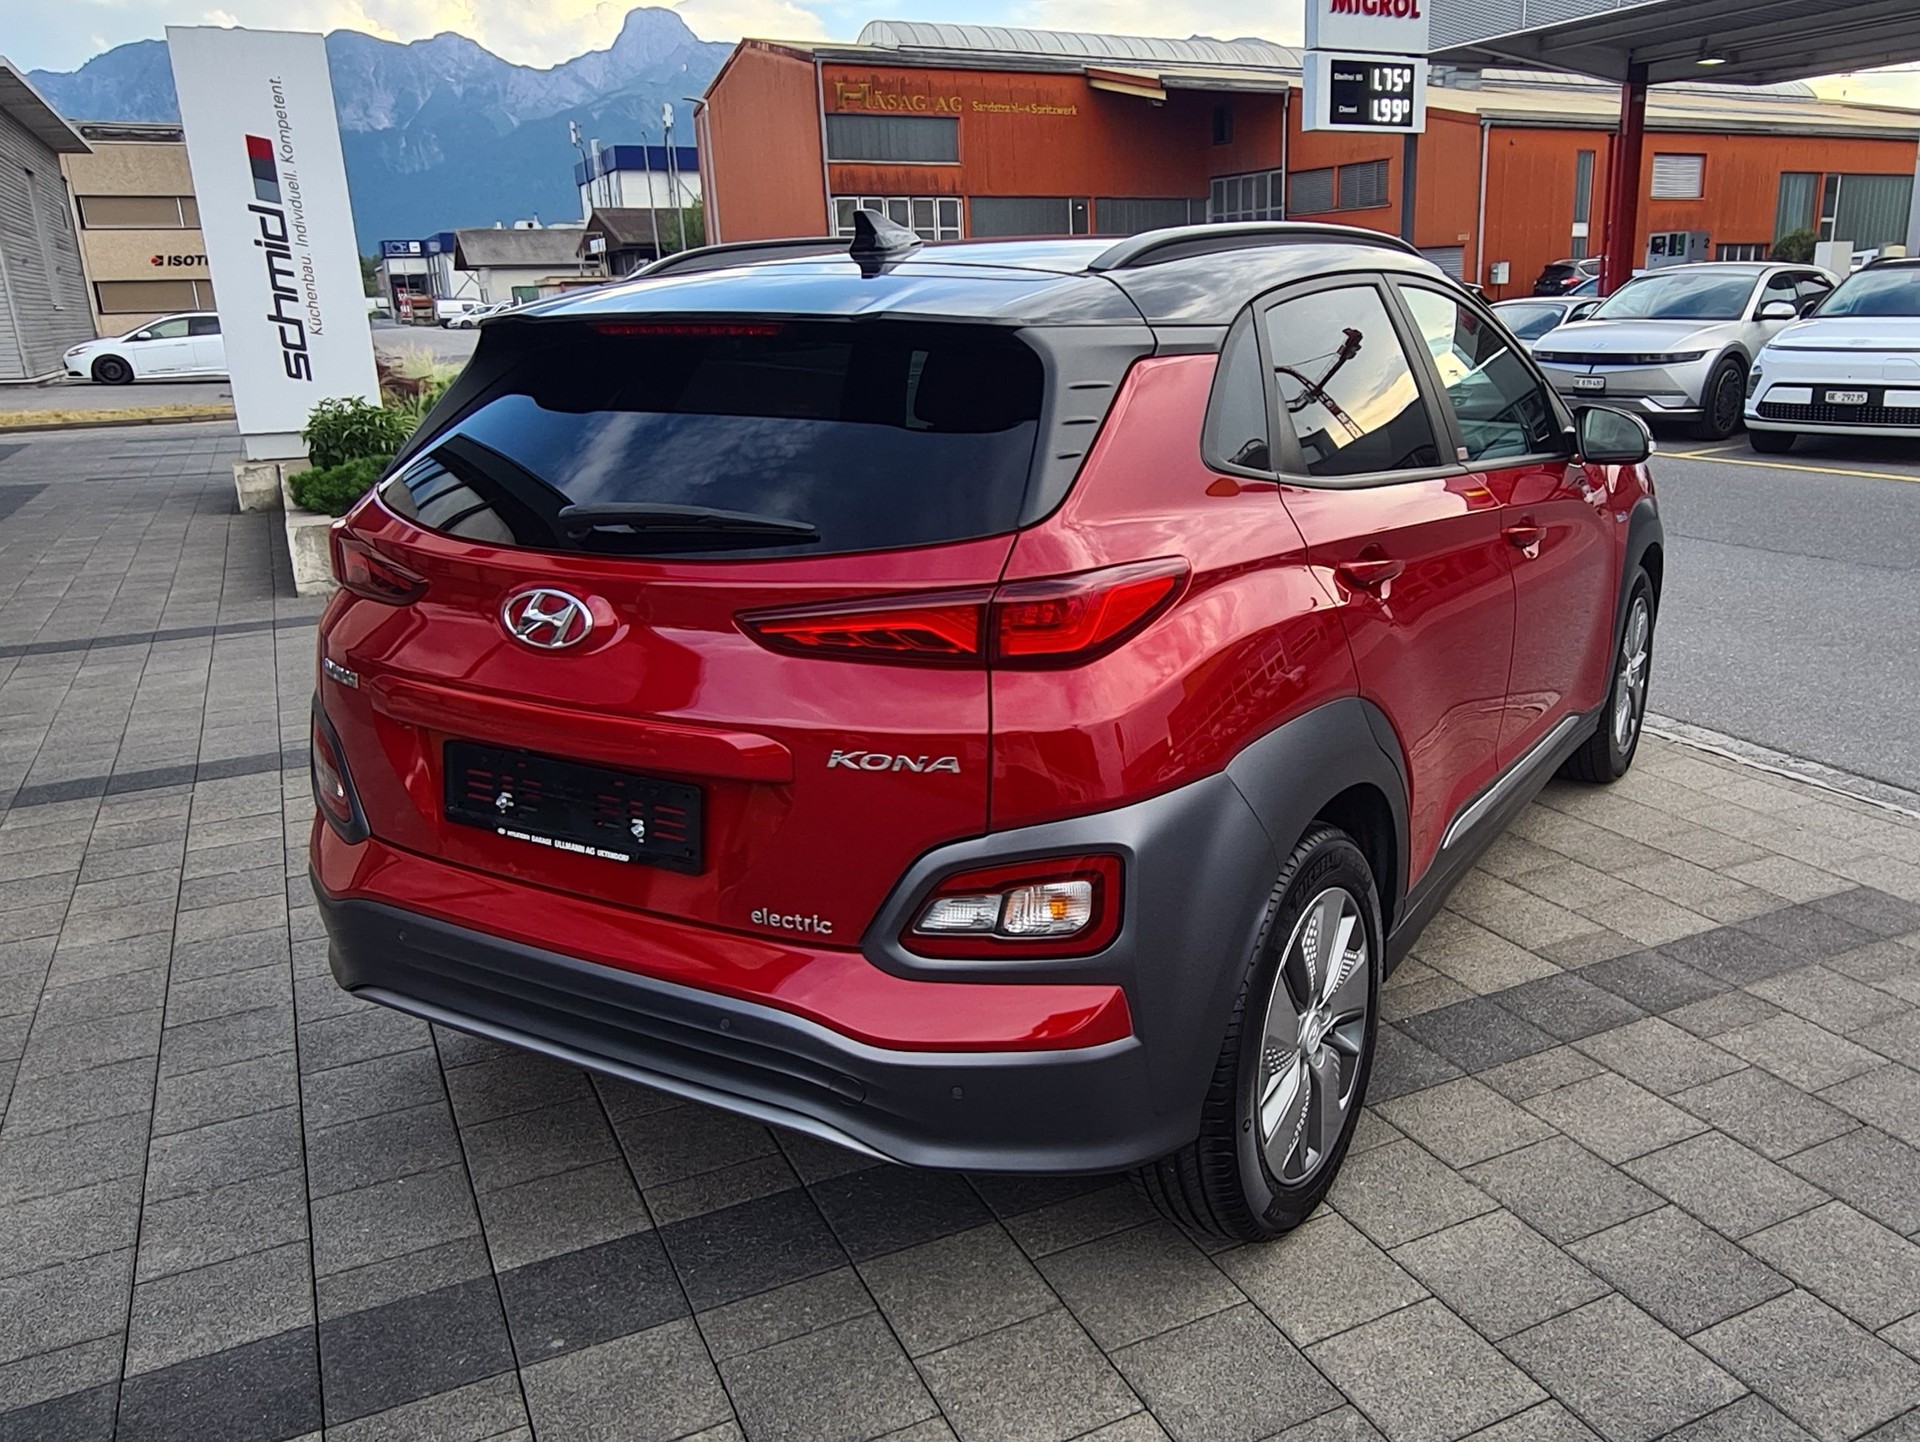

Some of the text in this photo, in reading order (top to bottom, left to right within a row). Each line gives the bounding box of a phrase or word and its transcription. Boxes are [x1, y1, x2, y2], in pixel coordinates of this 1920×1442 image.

[1330, 0, 1421, 19] MIGROL
[935, 96, 962, 112] AG
[1338, 105, 1358, 113] Diesel
[268, 75, 324, 336] Küchenbau. Individuell. Kompetent.
[247, 203, 313, 382] schmid
[826, 749, 961, 774] KONA
[554, 839, 585, 854] ULLMANN
[751, 907, 833, 934] electric
